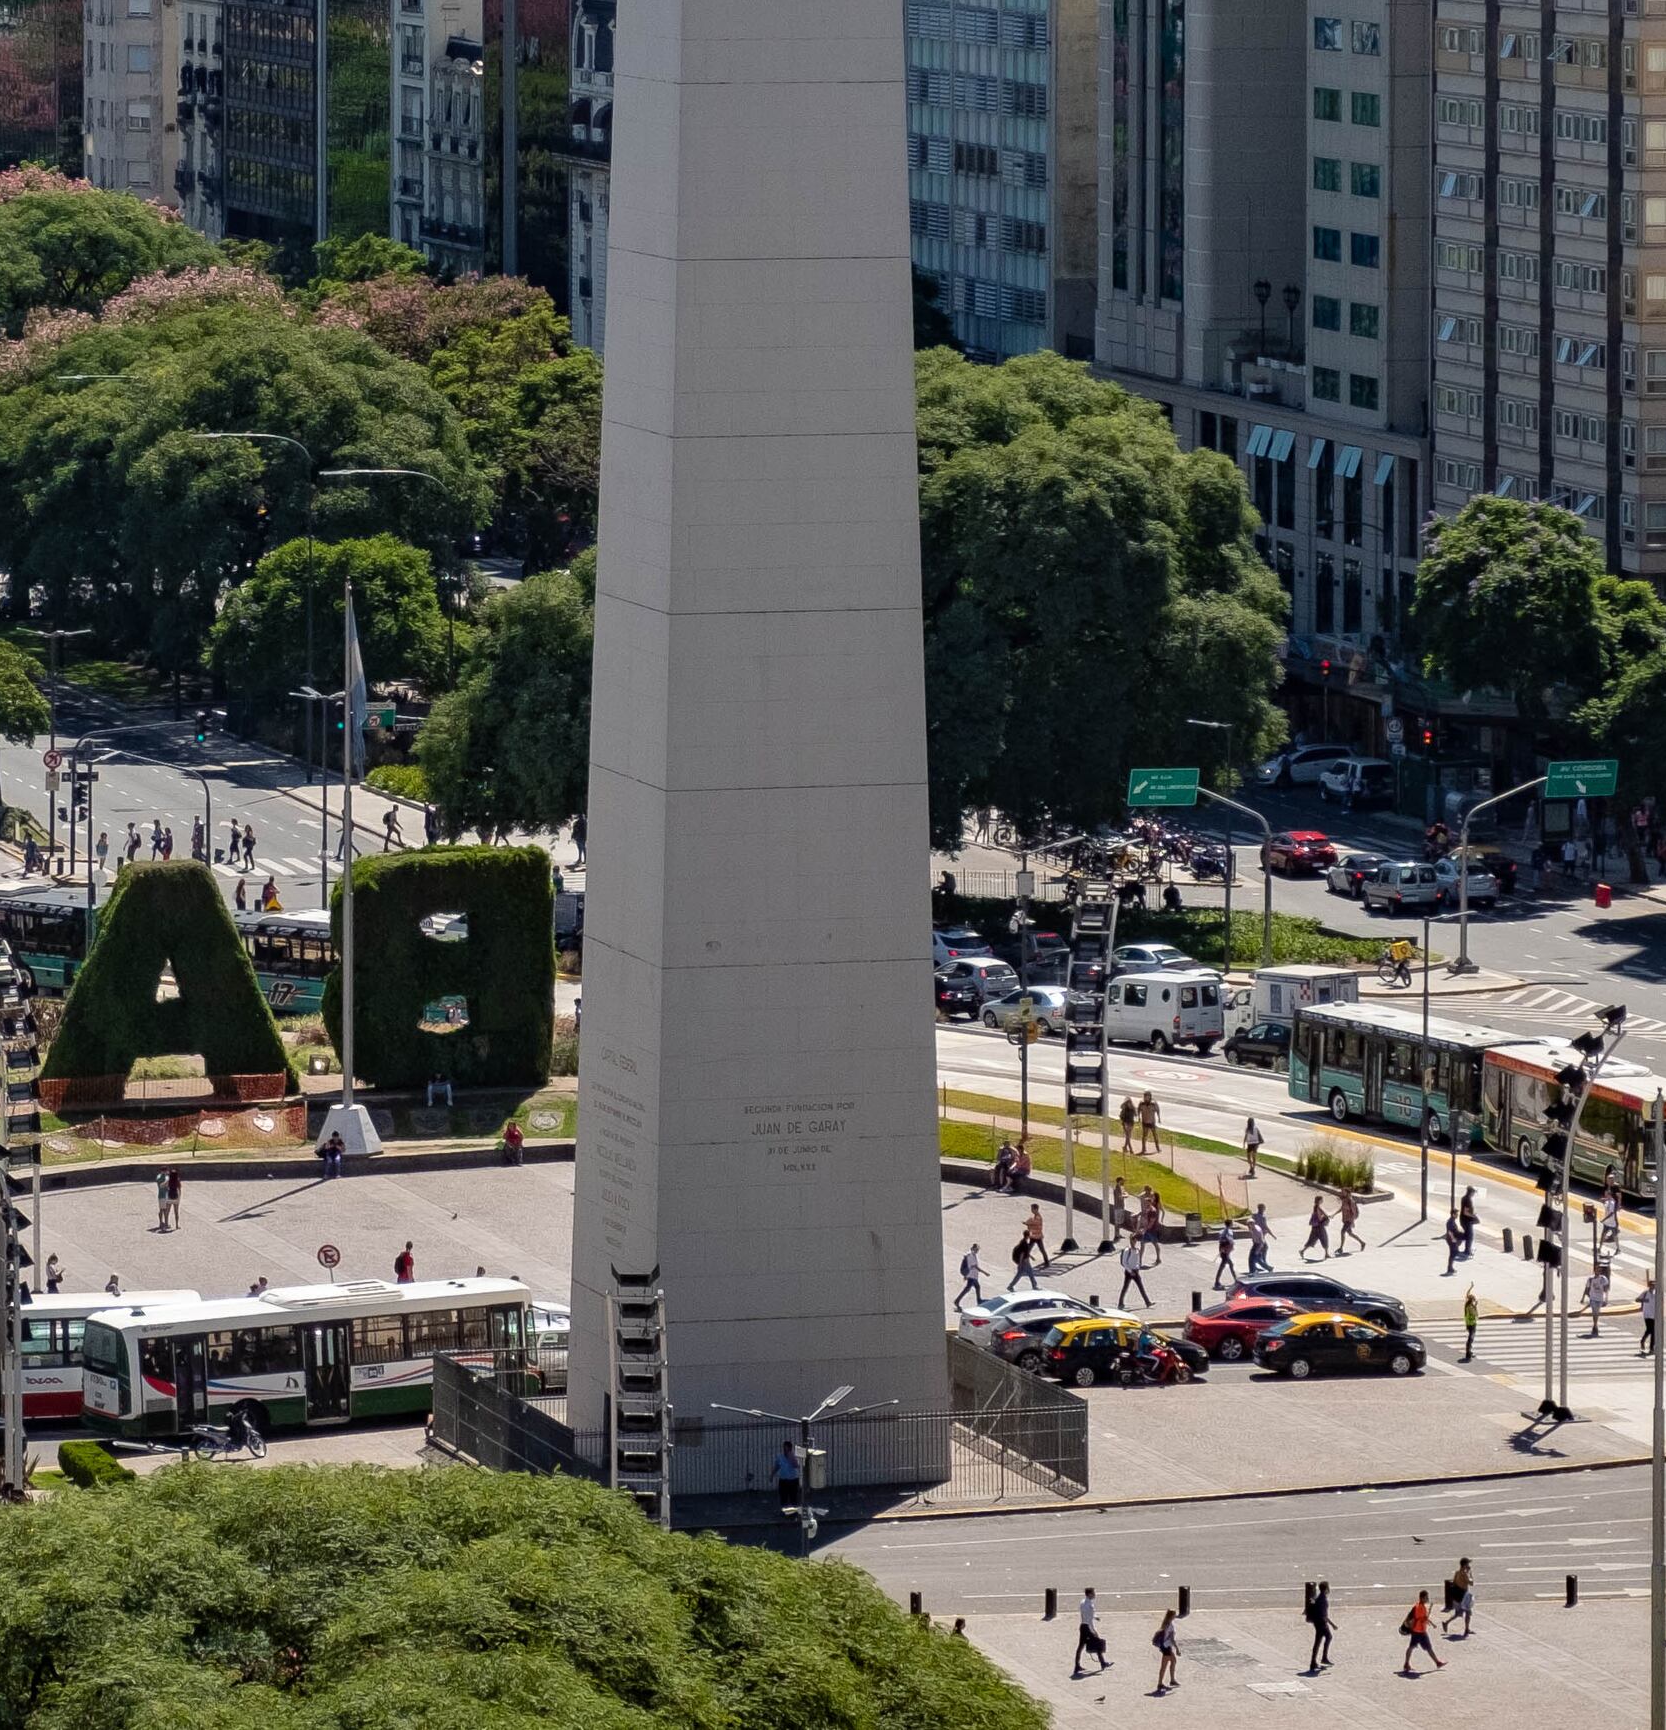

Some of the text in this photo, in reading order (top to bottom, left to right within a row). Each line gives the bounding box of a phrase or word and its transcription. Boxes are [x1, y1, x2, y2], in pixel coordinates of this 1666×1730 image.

[269, 981, 295, 1006] 17
[744, 1104, 782, 1115] SEGUNDA
[786, 1103, 834, 1113] FUNDACION
[751, 1119, 847, 1136] JUAN DE GARAY
